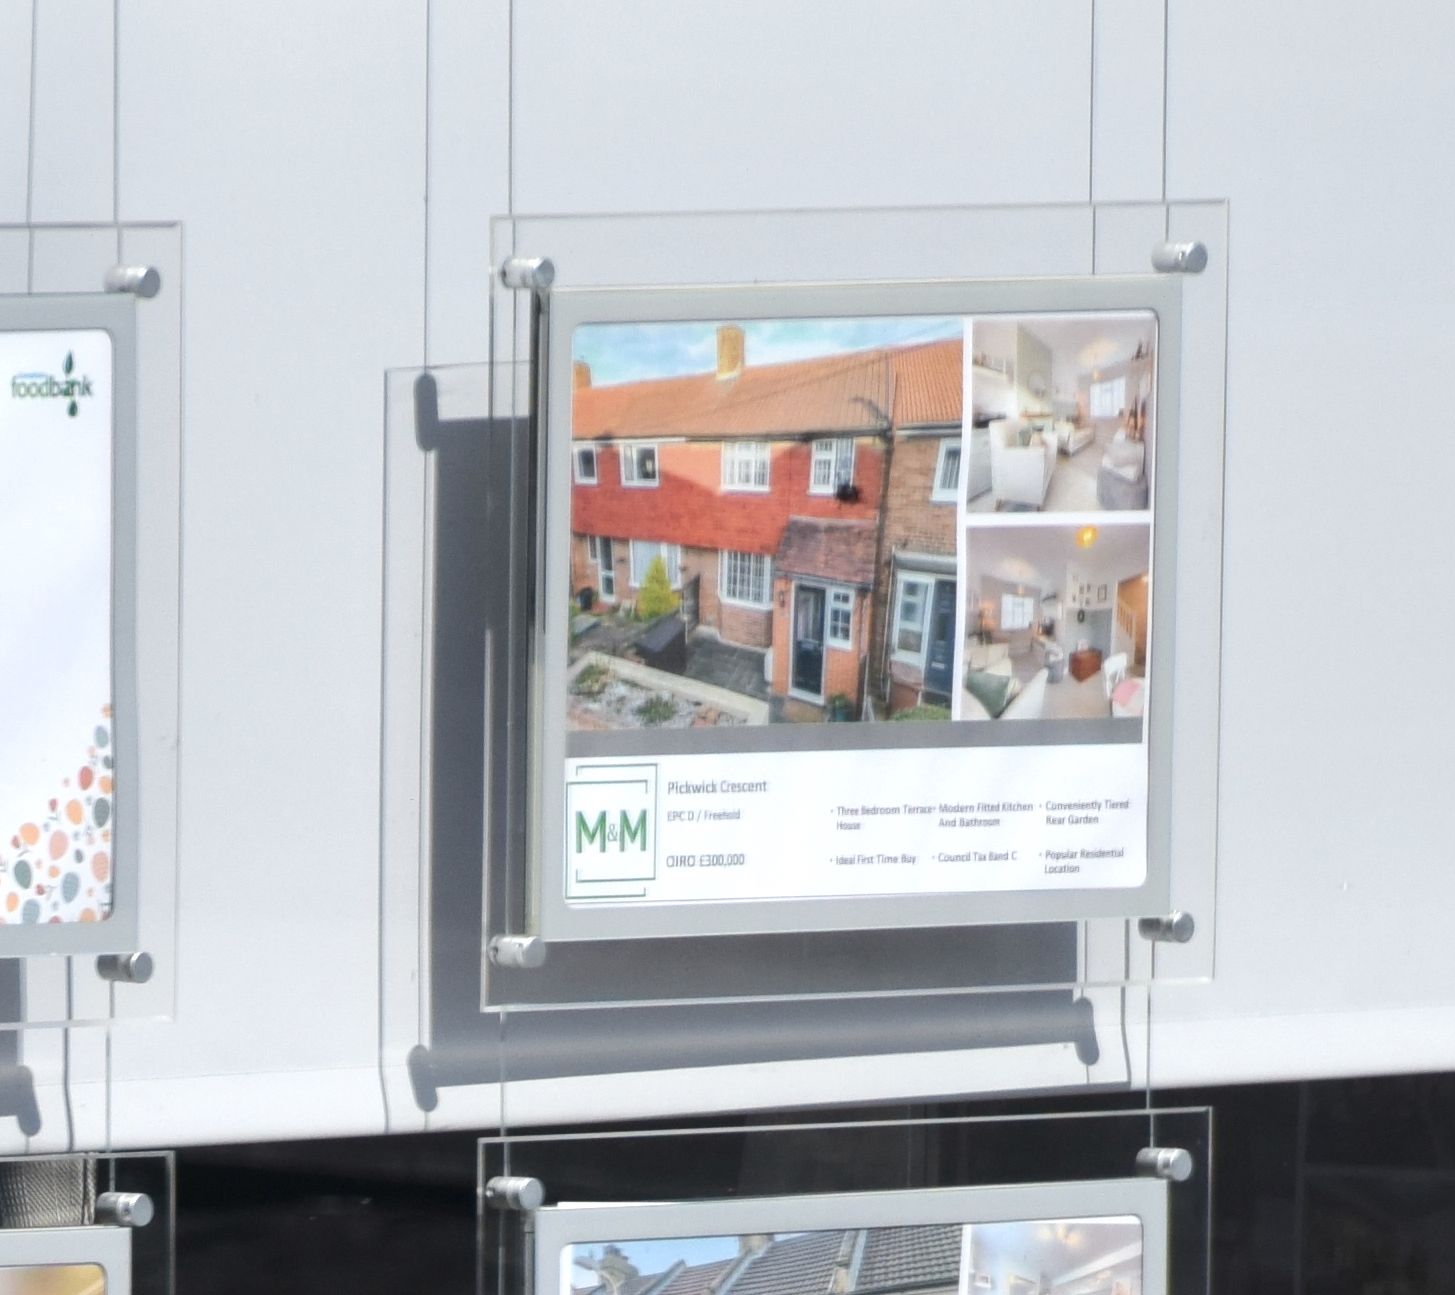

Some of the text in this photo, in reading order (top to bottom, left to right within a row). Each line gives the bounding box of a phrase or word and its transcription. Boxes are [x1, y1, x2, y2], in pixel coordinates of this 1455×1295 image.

[667, 780, 767, 795] Pickwick Crescent
[667, 810, 686, 822] EPC
[576, 809, 647, 853] M&M
[667, 853, 745, 869] OIRO £300,000
